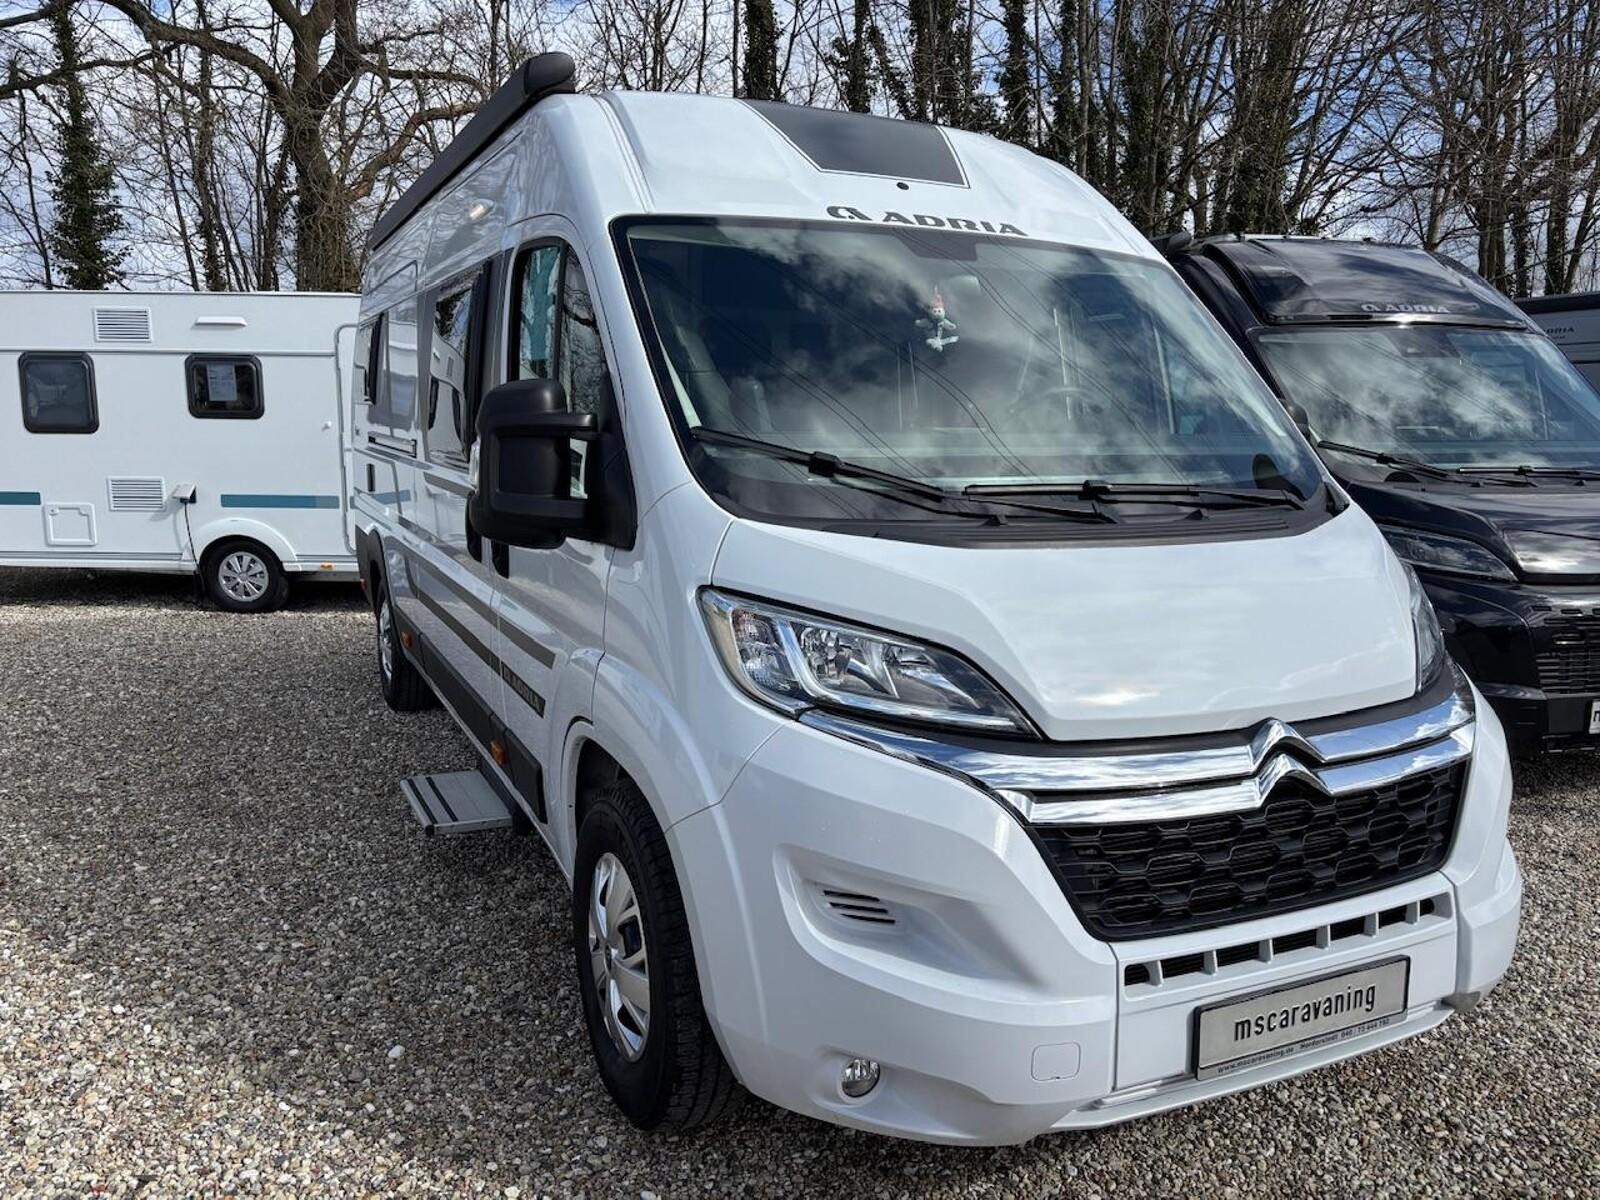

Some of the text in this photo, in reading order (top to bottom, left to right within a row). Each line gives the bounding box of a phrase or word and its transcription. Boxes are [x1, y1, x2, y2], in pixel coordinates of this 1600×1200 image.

[882, 211, 1029, 236] ADRIA
[1385, 304, 1450, 313] ADRIA
[1234, 984, 1376, 1042] mscaravaning
